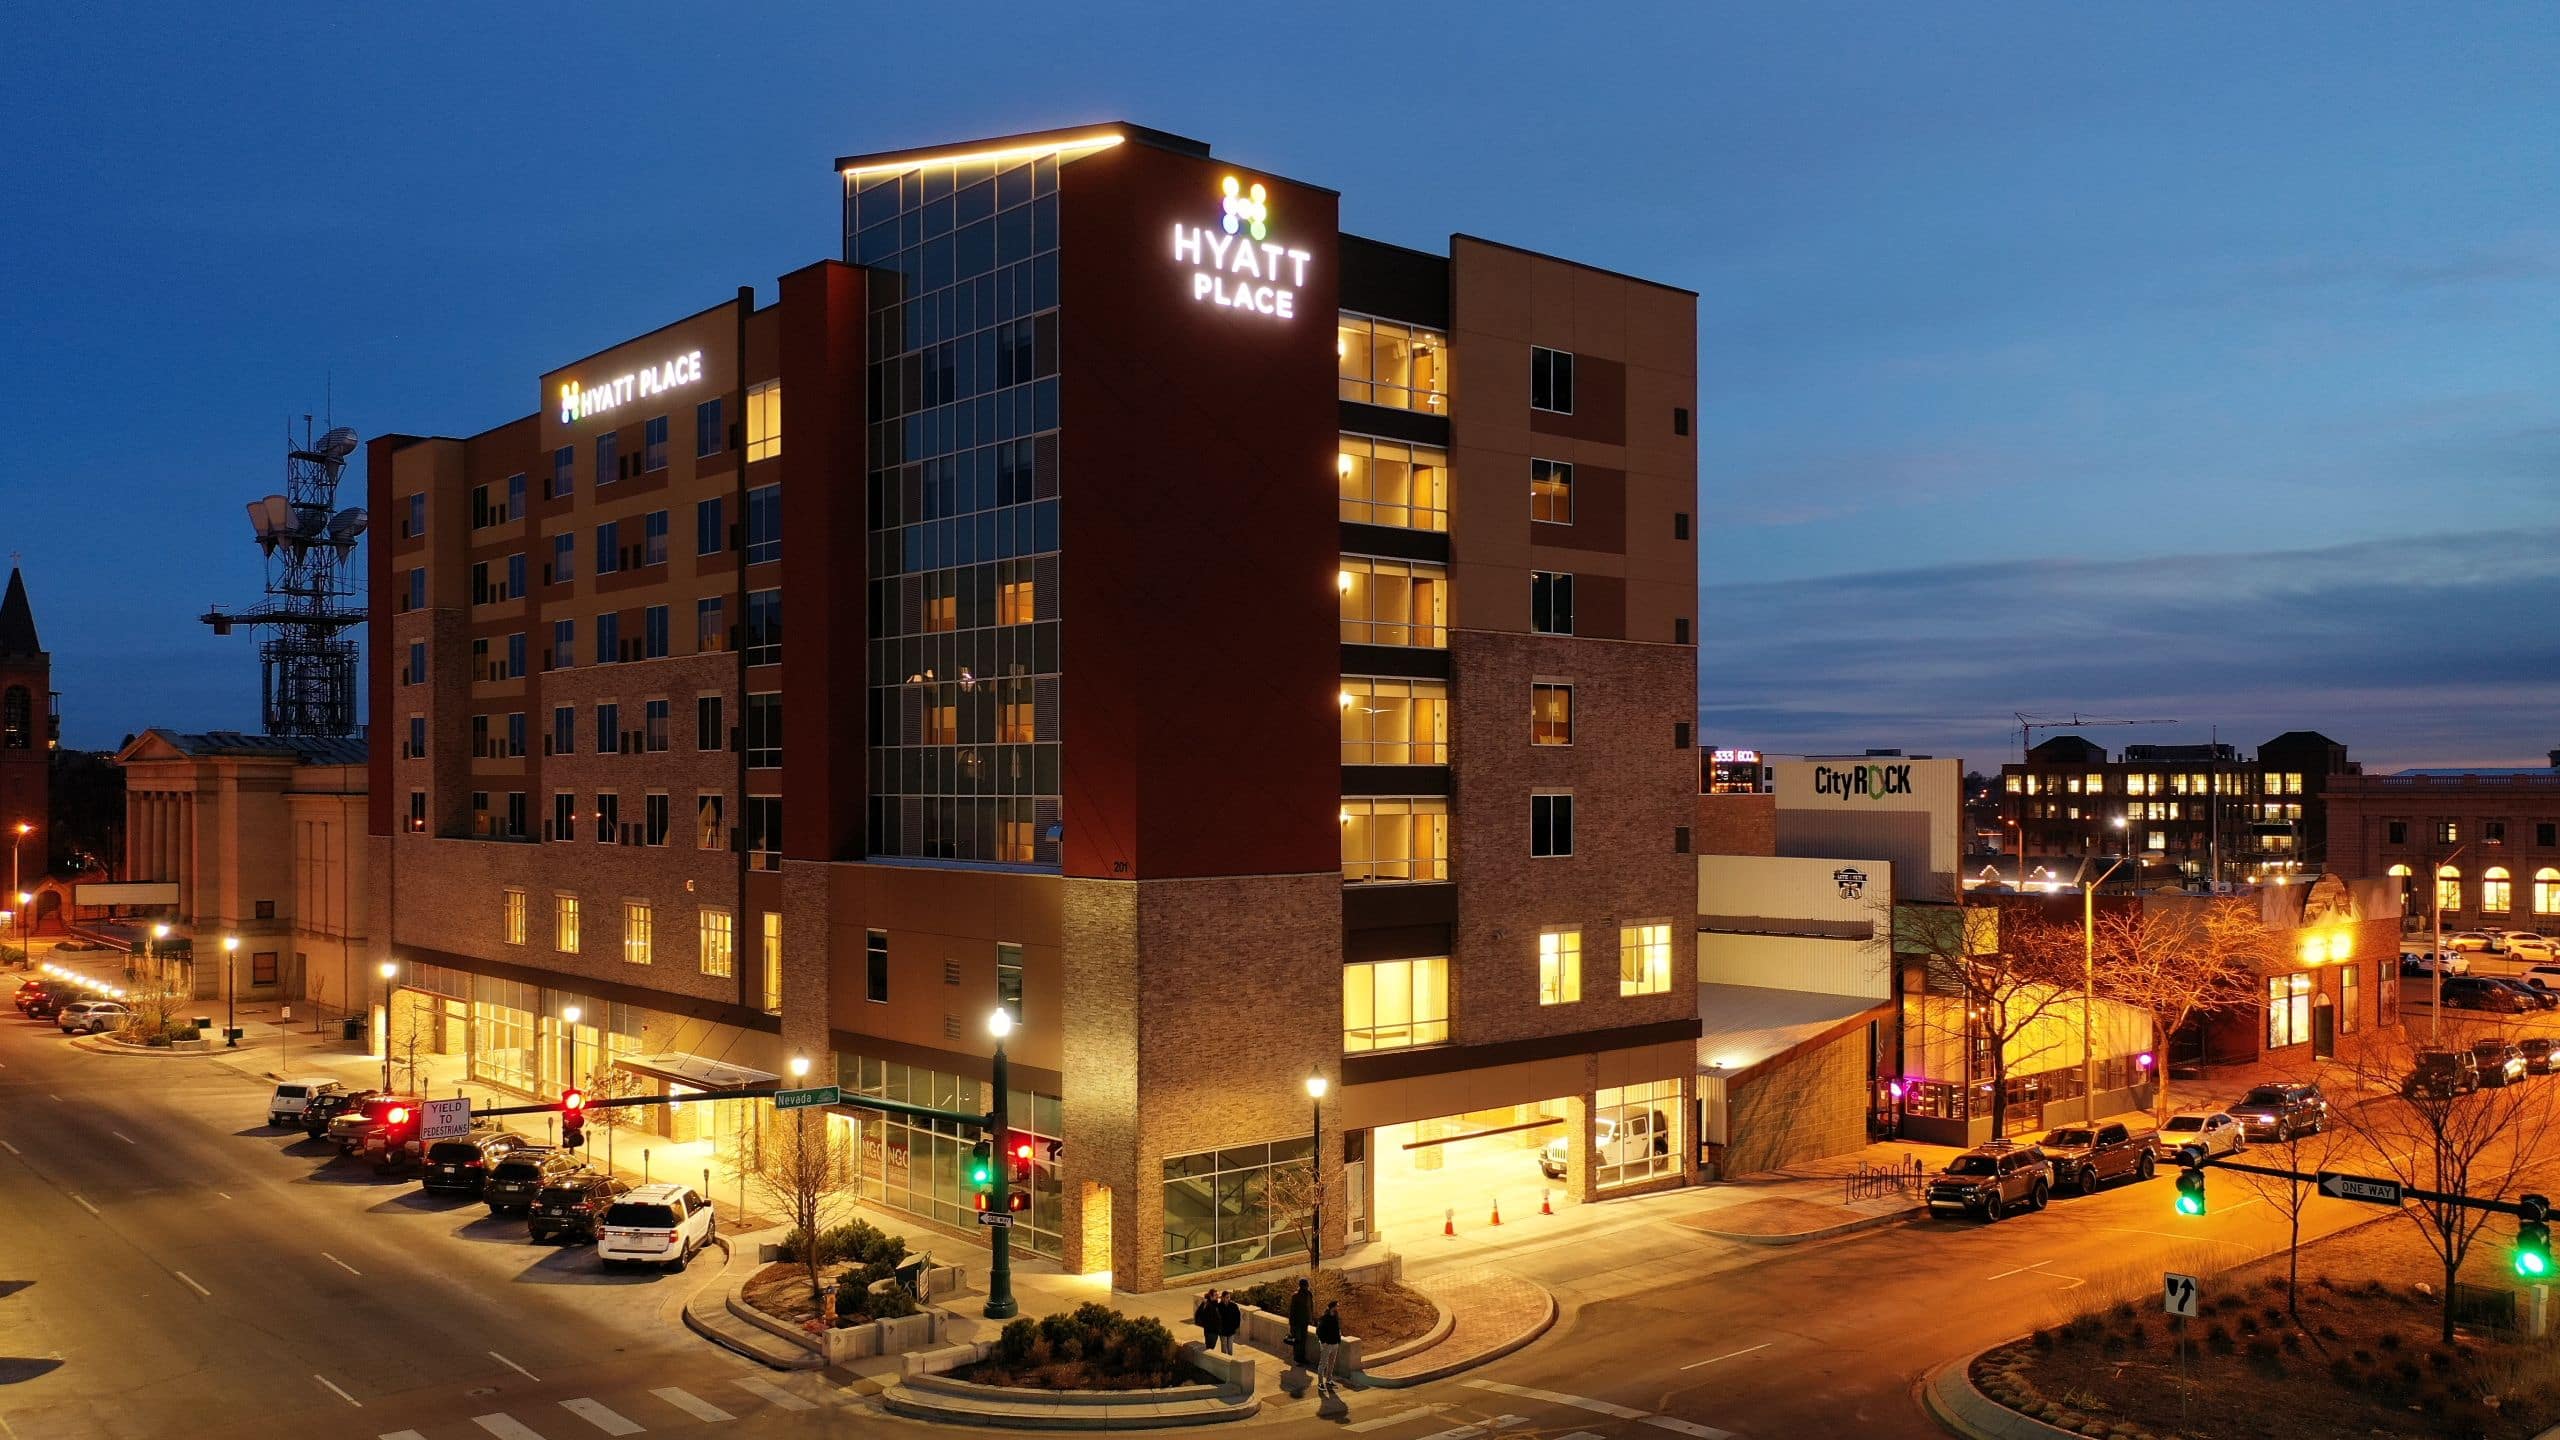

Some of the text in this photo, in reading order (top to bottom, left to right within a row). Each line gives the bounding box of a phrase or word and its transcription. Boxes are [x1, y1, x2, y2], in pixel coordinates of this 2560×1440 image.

[1174, 223, 1311, 287] HYATT
[1195, 273, 1294, 319] PLACE
[580, 350, 702, 418] HYATT PLACE
[778, 1093, 812, 1106] Nevada
[431, 1102, 462, 1113] YIELD
[439, 1114, 453, 1124] TO
[423, 1124, 468, 1137] PEDESTRIANS
[2342, 1181, 2391, 1198] ONE WAY
